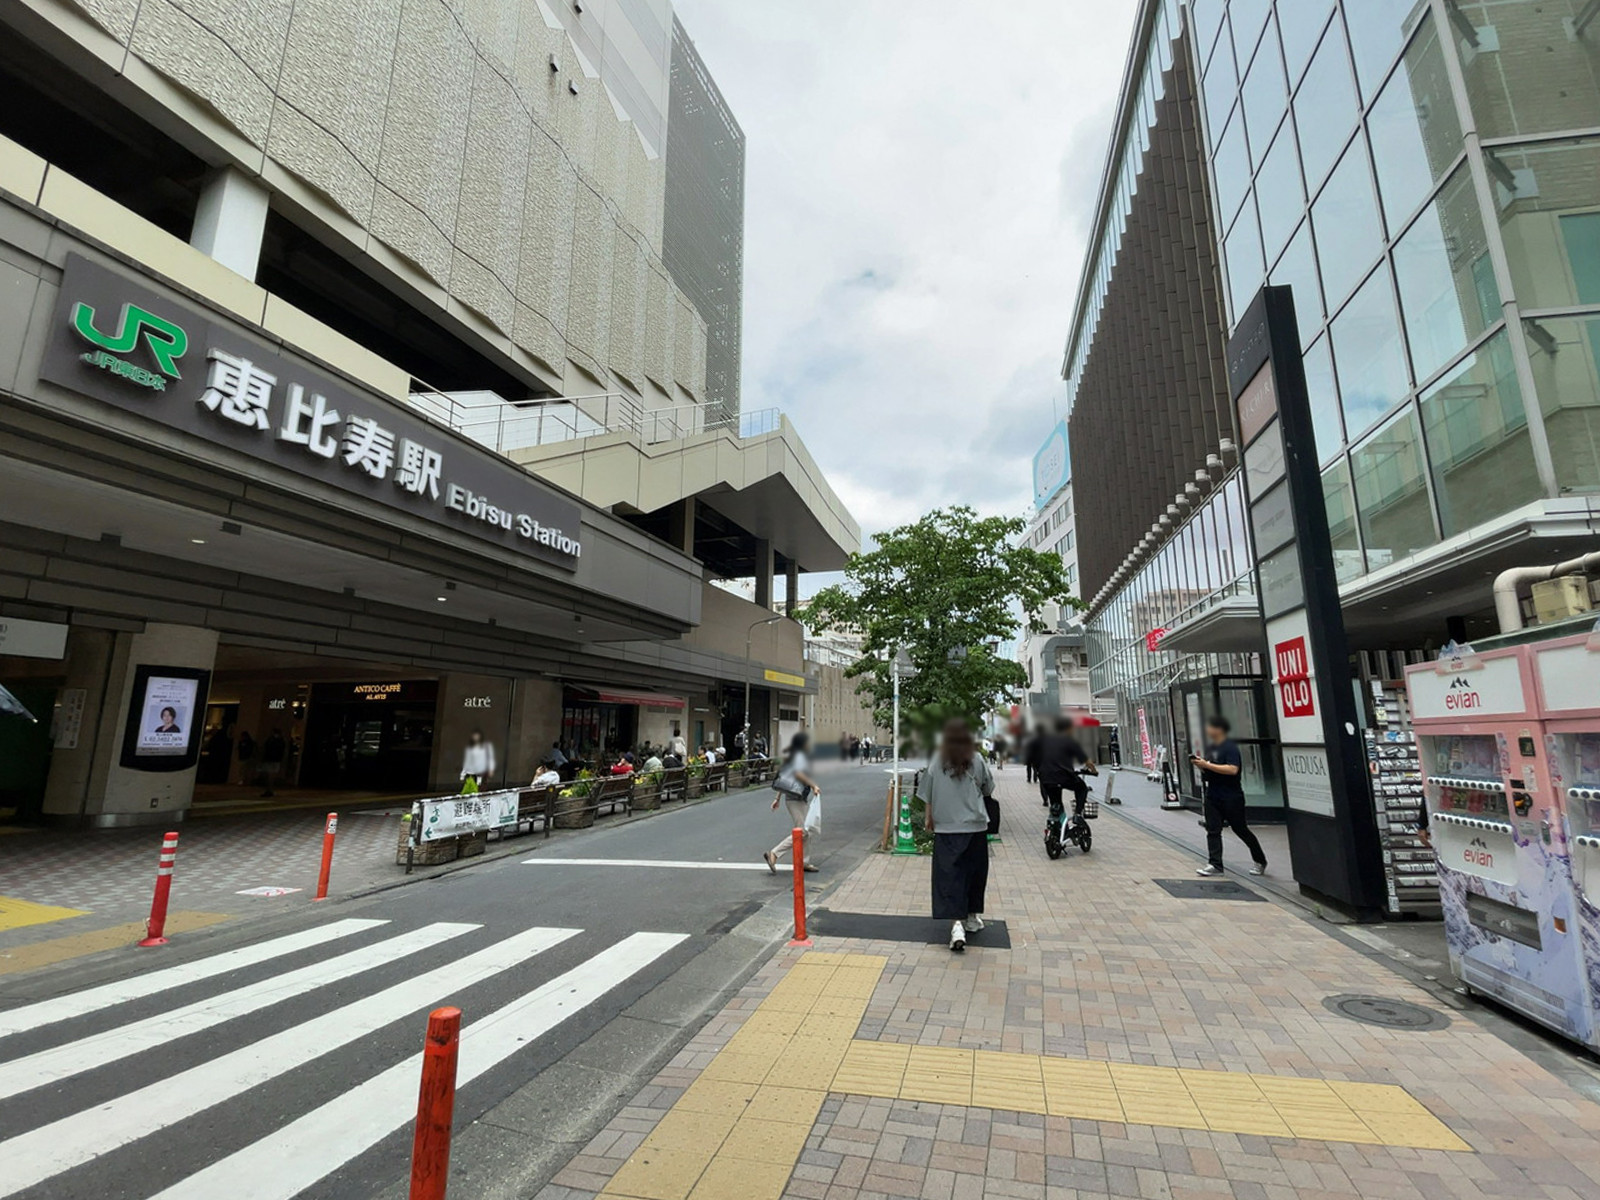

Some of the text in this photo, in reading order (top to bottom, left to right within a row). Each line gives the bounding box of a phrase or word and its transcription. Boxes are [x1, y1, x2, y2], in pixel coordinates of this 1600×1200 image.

[69, 301, 188, 379] JR
[198, 347, 582, 558] 恵比寿駅 Ebisu Station
[1278, 648, 1303, 677] UNI
[353, 685, 380, 693] ANTICO
[1283, 682, 1309, 713] QLO
[1446, 690, 1480, 710] evian
[1287, 755, 1326, 777] MEDUSA
[1464, 849, 1493, 868] evian
